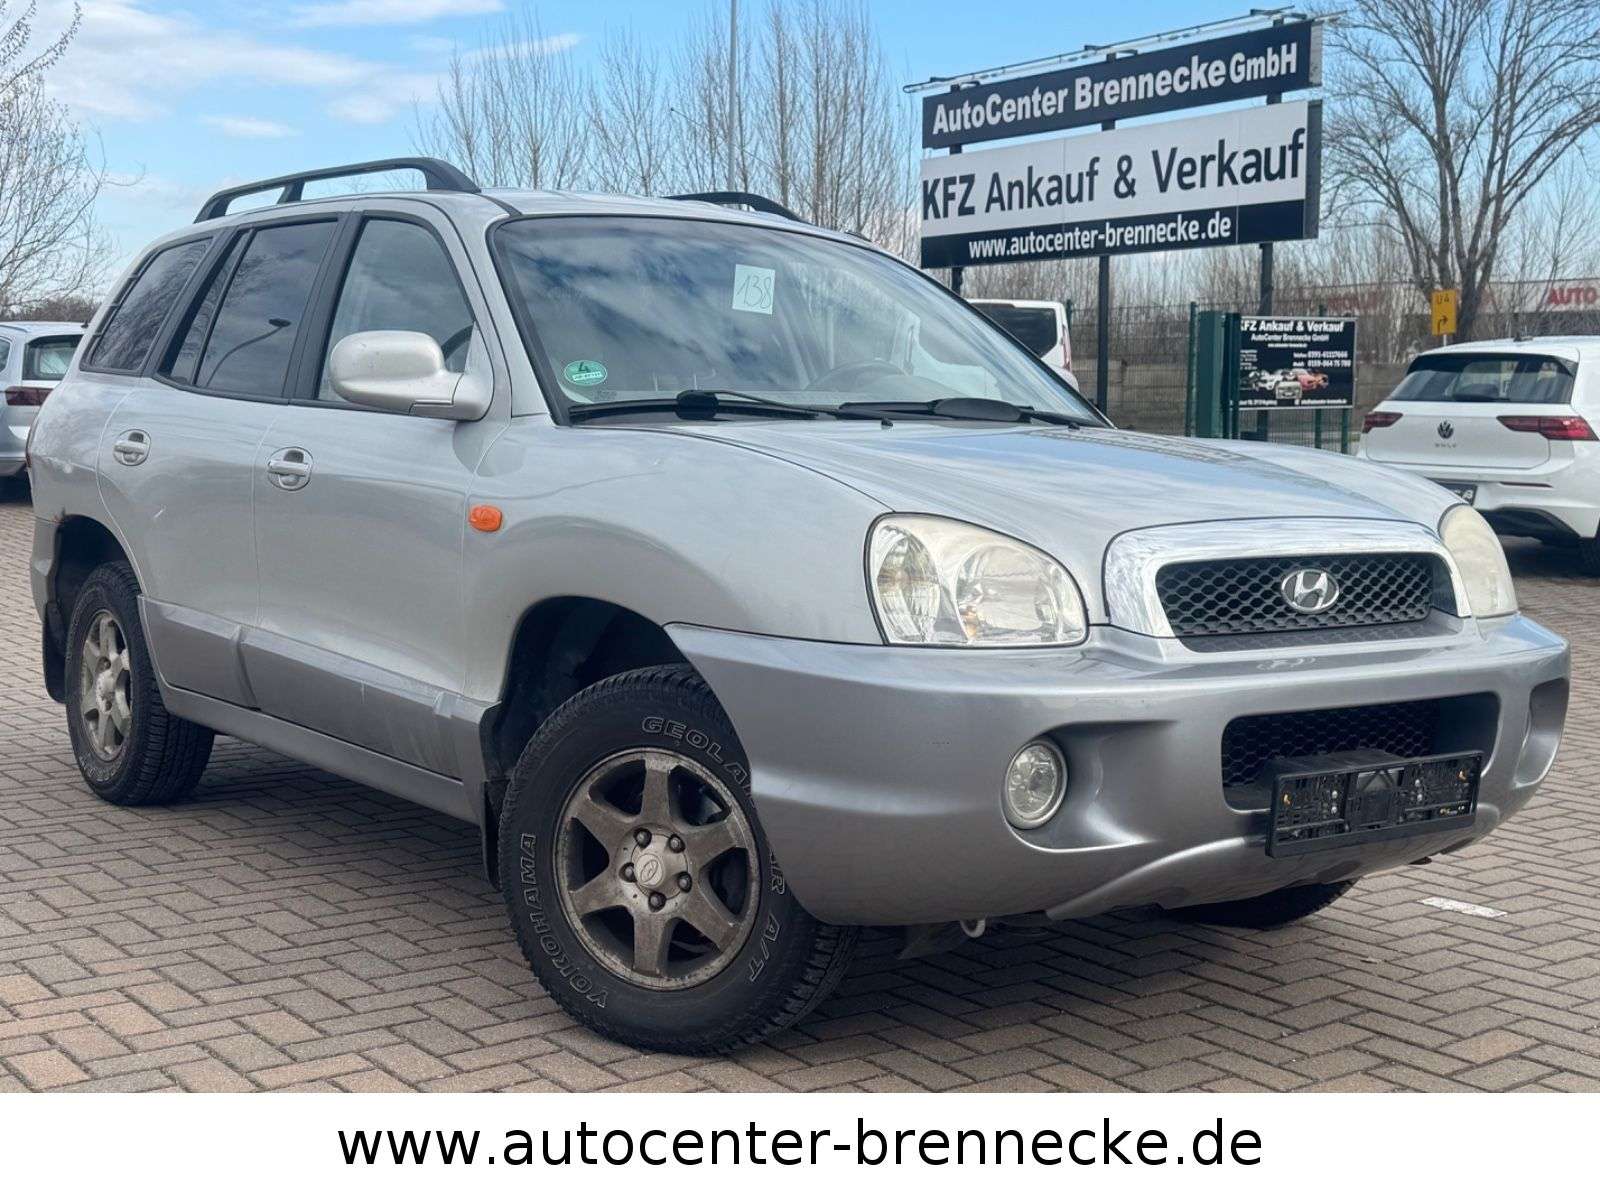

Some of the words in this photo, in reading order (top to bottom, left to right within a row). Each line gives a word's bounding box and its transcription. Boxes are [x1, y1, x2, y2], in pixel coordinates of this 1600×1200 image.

[932, 86, 1068, 136] AutoCenter
[1074, 55, 1226, 111] Brennecke
[1229, 42, 1298, 85] GmbH
[922, 173, 976, 220] KFZ
[984, 157, 1101, 214] Ankauf
[1113, 153, 1137, 200] &
[1151, 128, 1306, 194] Verkauf
[968, 210, 1233, 260] www.autocenter-brennecke.de
[1258, 320, 1294, 332] Ankauf
[1307, 321, 1345, 332] Verkauf
